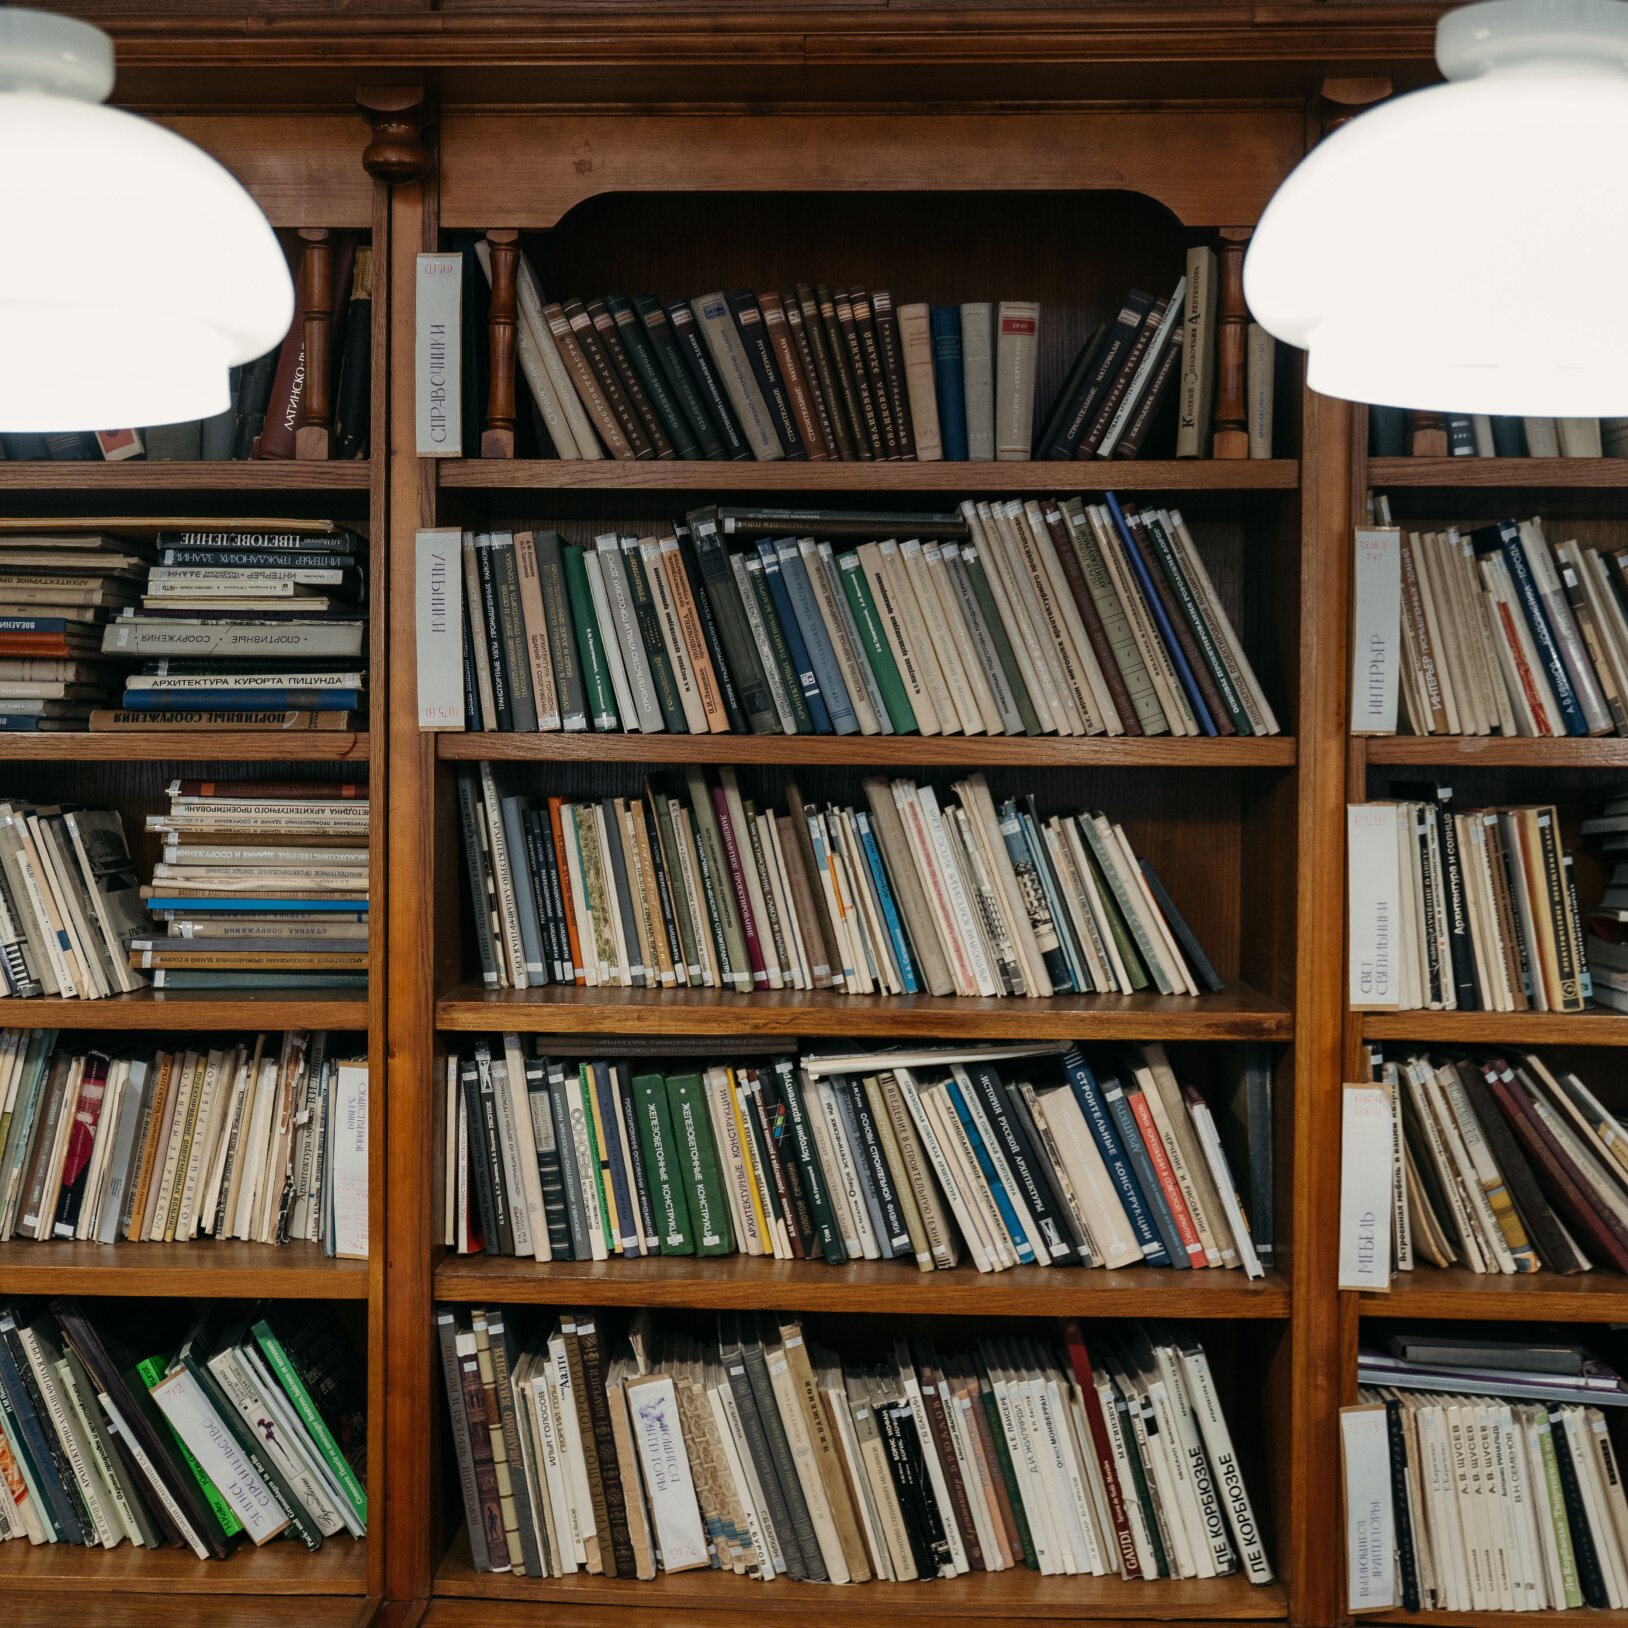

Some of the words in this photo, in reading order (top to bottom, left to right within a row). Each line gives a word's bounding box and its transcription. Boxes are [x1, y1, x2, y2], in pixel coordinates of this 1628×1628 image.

[757, 339, 775, 382] МАТЕРИАЛЫ
[780, 337, 797, 381] МАТЕРИАЛЫ
[848, 332, 864, 375] ЗДАНИЙ
[863, 330, 880, 374] ЗДАНИЙ
[431, 324, 446, 442] СПРАВОЧНИКИ
[1067, 385, 1097, 440] СТРОИТЕЛЬНЫЕ
[1095, 339, 1121, 383] МАТЕРИАЛЫ
[773, 387, 796, 443] СТРОИТЕЛЬНЫЕ
[795, 386, 816, 442] СТРОИТЕЛЬНЫЕ
[180, 532, 300, 548] ЦВЕТОВЕДЕНИЕ
[219, 553, 290, 563] ГРАЖДАНСКИХ
[295, 555, 340, 565] ИНТЕРЬЕР
[16, 577, 88, 587] АРХИТЕКТУРНОЕ
[246, 572, 296, 580] ИНТЕРЬЕР
[606, 552, 619, 577] ДОРОГ
[1401, 547, 1415, 583] ЗДАНИЙ
[431, 552, 446, 632] УЧЕБНИКИ
[484, 583, 497, 638] ПРОМЫШЛЕННЫХ
[612, 577, 630, 623] ГОРОДСКИХ
[964, 597, 981, 632] ГОРОДСКИХ
[141, 634, 210, 643] СООРУЖЕНИЯ
[231, 635, 300, 644] СПОРТИВНЫЕ
[492, 641, 500, 658] УЗЛЫ
[625, 628, 637, 651] УЛИЦ
[976, 631, 995, 671] ПОДГОТОВКА
[152, 678, 229, 687] АРХИТЕКТУРА
[234, 677, 283, 685] КУРОРТА
[288, 677, 342, 685] ПИЦУНДА
[494, 661, 504, 710] ТРАНСПОРТНЫЕ
[630, 650, 651, 713] СТРОИТЕЛЬСТВО
[1369, 634, 1386, 715] ИНТЕРЬЕР
[1422, 654, 1443, 710] ИНТЕРЬЕР
[113, 712, 201, 723] СООРУЖЕНИЯ
[184, 805, 252, 814] ПРОЕКТИРОВАНИ
[720, 814, 738, 871] ЛАНДШАФТНОЕ
[732, 871, 754, 938] ПРОЕКТИРОВАНИЕ
[1376, 902, 1389, 995] СВЕТИЛЬНИКИ
[485, 1101, 494, 1129] РИСУНОК
[718, 1088, 741, 1159] КОНСТРУКЦИИ
[885, 1086, 907, 1136] ВВЕДЕНИЕ
[647, 1103, 669, 1182] ЖЕЛЕЗОБЕТОННЫЕ
[681, 1102, 703, 1181] ЖЕЛЕЗОБЕТОННЫЕ
[793, 1123, 812, 1162] История
[829, 1117, 850, 1170] эстетических
[900, 1135, 910, 1143] В
[979, 1073, 1003, 1115] ИСТОРИЯ
[996, 1114, 1021, 1155] РУССКОЙ
[1013, 1154, 1046, 1214] АРХИТЕКТУРЫ
[1075, 1070, 1118, 1158] СТРОИТЕЛЬНЫЕ
[1113, 1159, 1154, 1242] КОНСТРУКЦИИ
[1162, 1130, 1185, 1172] ЧЕРЧЕНИЕ
[173, 1139, 190, 1195] СОВРЕМЕННЫХ
[859, 1112, 874, 1145] ОСНОВЫ
[867, 1145, 891, 1202] СТРОИТЕЛЬНОЙ
[884, 1202, 901, 1234] ФИЗИКИ
[902, 1143, 930, 1215] СТРОИТЕЛЬНУЮ
[936, 1159, 958, 1203] АРХИТЕКТУРА
[1178, 1174, 1187, 1183] И
[735, 1163, 758, 1239] АРХИТЕКТУРНЫЕ
[1181, 1184, 1208, 1235] РИСОВАНИЕ
[1358, 1211, 1376, 1273] МЕБЕЛЬ
[26, 1332, 42, 1361] СРЕДА
[443, 1343, 460, 1393] РИСУНКИ
[452, 1409, 468, 1457] ЧЕРТЕЖИ
[537, 1390, 552, 1438] ГОЛОСОВ
[880, 1409, 893, 1436] ИОФАН
[910, 1394, 932, 1445] Г.Б.БАРХИН
[999, 1394, 1015, 1434] ЛАНСЕРЕ
[1038, 1394, 1057, 1445] МОНФЕРРАН
[249, 1453, 265, 1474] Berlin
[545, 1439, 558, 1467] ИЛЬЯ
[887, 1438, 899, 1461] БОРИС
[1050, 1444, 1065, 1469] Огюст
[1450, 1423, 1466, 1468] ЩУСЕВ
[1465, 1424, 1479, 1468] ЩУСЕВ
[1479, 1424, 1493, 1468] ЩУСЕВ
[1504, 1431, 1519, 1481] СЕМЕНОВ
[344, 1474, 364, 1505] Comment
[461, 1465, 479, 1526] ВОРОНИХИН
[1187, 1444, 1224, 1540] КОРБЮЗЬЕ
[1457, 1470, 1467, 1482] В.
[1459, 1482, 1470, 1496] А.
[1471, 1470, 1481, 1482] В.
[1473, 1482, 1483, 1496] А.
[1484, 1469, 1494, 1481] В.
[1486, 1482, 1497, 1495] А.
[1543, 1452, 1565, 1518] Творческий
[1217, 1451, 1259, 1548] КОРБЮЗЬЕ
[294, 1517, 306, 1530] und
[751, 1531, 767, 1567] БУРОВ
[1118, 1528, 1137, 1570] GAUDI
[1212, 1539, 1233, 1567] ЛЕ
[1247, 1548, 1267, 1574] ЛЕ
